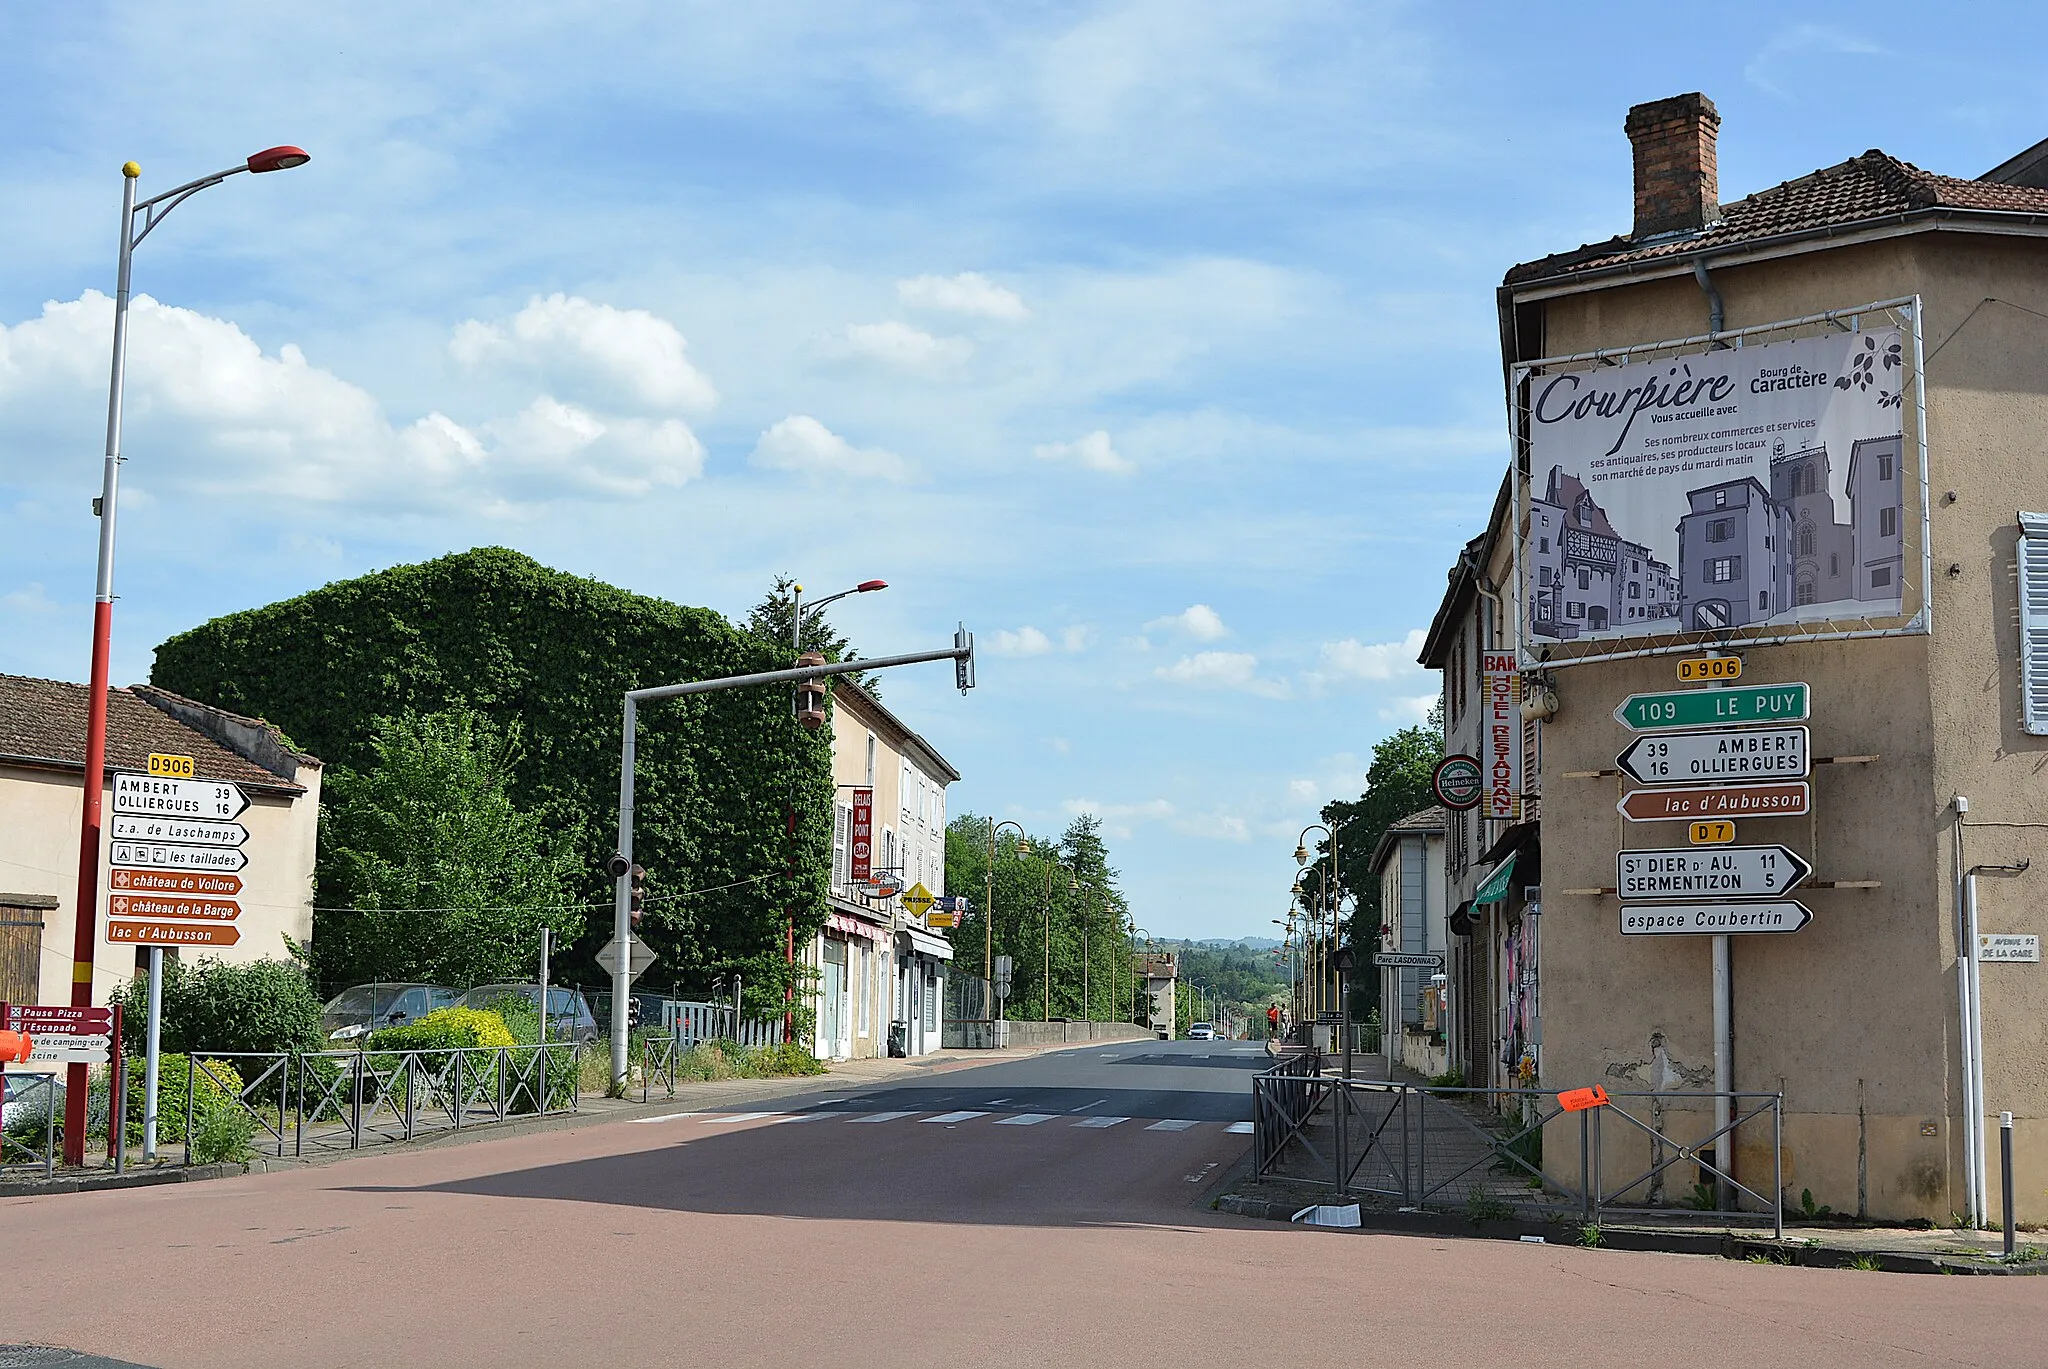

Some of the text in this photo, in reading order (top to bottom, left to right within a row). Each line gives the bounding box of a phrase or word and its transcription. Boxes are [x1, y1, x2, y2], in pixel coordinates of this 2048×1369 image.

[1760, 364, 1802, 380] Bourg de
[1750, 370, 1828, 394] Caractère
[1535, 363, 1736, 457] Courpière
[1651, 405, 1738, 424] Vous accueille avec
[1644, 419, 1816, 448] Ses nombreux commerces et services
[1590, 439, 1767, 469] ses antiquaires, ses producteurs locaux
[1592, 454, 1753, 482] son marché de pays du mardi matin
[1492, 675, 1511, 720] HOTEL
[1638, 693, 1797, 721] 109 LE PUY
[1647, 735, 1799, 758] 39 AMBERT
[151, 757, 191, 774] D906
[1491, 725, 1512, 815] RESTAURANT
[1650, 755, 1799, 776] 16 OLLIERGUES
[120, 780, 230, 800] AMBERT 39
[1441, 778, 1480, 788] Heineken
[119, 796, 230, 815] OLLIERGUES 16
[854, 793, 871, 806] RELAIS
[1665, 792, 1801, 812] lac d'Aubusson
[858, 809, 867, 822] DU
[118, 824, 236, 842] z.a. de Laschamps
[855, 824, 869, 837] PONT
[170, 851, 236, 866] les taillades
[854, 846, 868, 855] BAR
[1648, 857, 1687, 873] DIER
[1711, 856, 1738, 870] AU.
[1760, 854, 1776, 869] 11
[133, 875, 235, 891] château de Vollore
[1626, 872, 1775, 891] SERMENTIZON 5
[903, 896, 931, 904] PRESSE
[131, 901, 234, 919] château de la Barge
[1627, 910, 1783, 934] espace Coubertin
[112, 926, 212, 941] lac d'Aubusson
[1994, 938, 2021, 946] AVENUE
[1377, 955, 1393, 964] Parc
[1982, 949, 2033, 957] DE LA GARE
[24, 1008, 83, 1018] Pause Pizza
[23, 1022, 77, 1032] l'Escapade
[41, 1037, 51, 1046] de
[53, 1038, 104, 1048] camping-car
